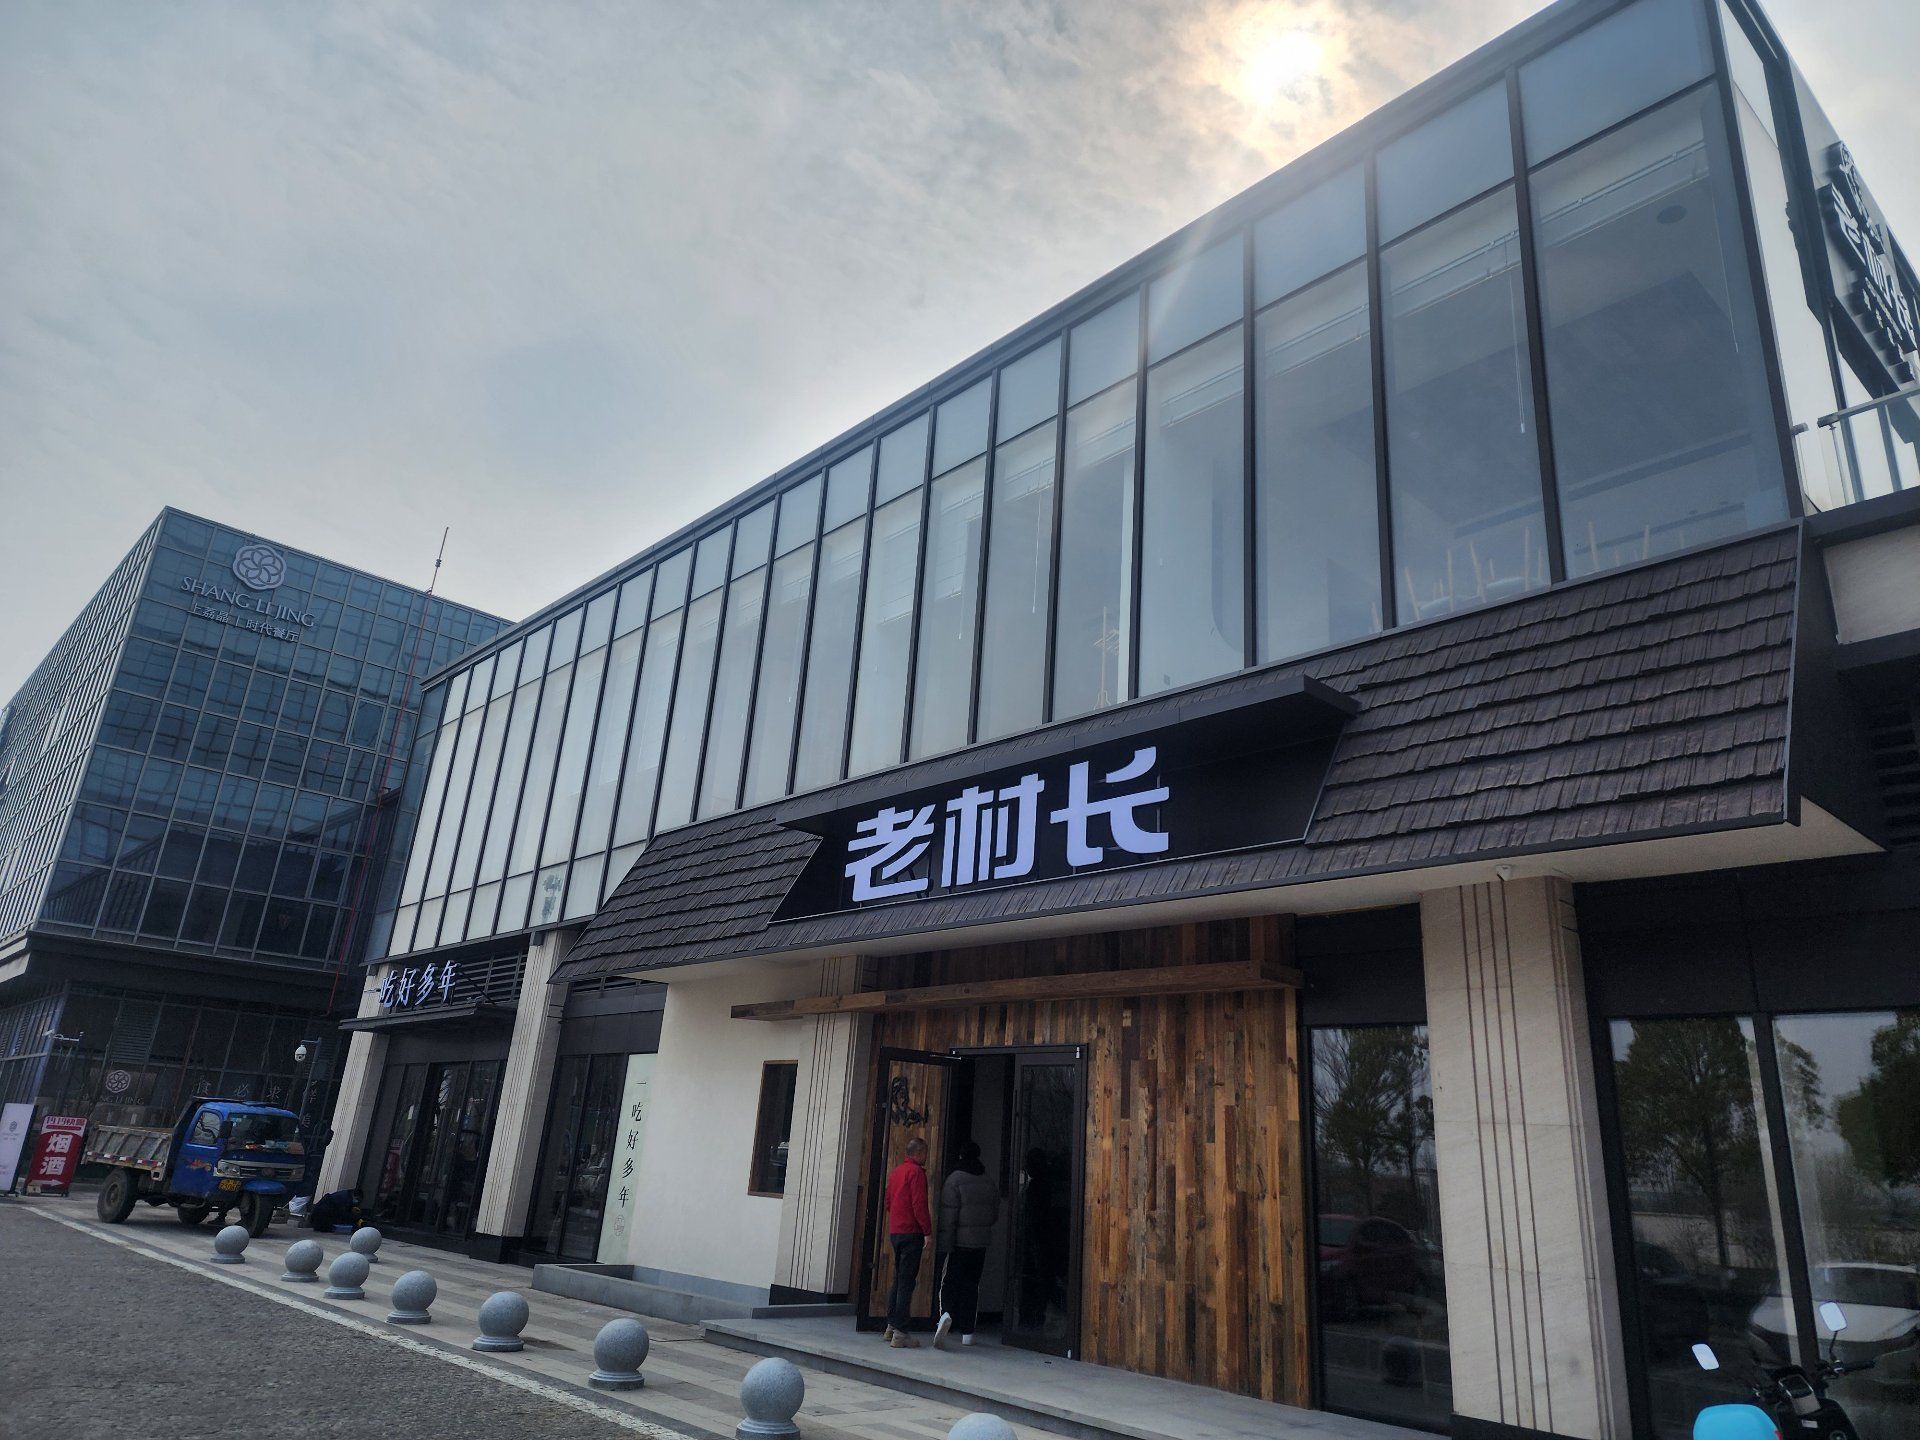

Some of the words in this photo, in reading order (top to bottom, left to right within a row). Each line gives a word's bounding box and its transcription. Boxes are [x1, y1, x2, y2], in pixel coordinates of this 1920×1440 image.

[181, 576, 250, 608] SHANG
[256, 598, 272, 614] LI
[274, 605, 315, 627] JING
[845, 746, 1170, 903] 老村长
[39, 1134, 73, 1175] 烟酒
